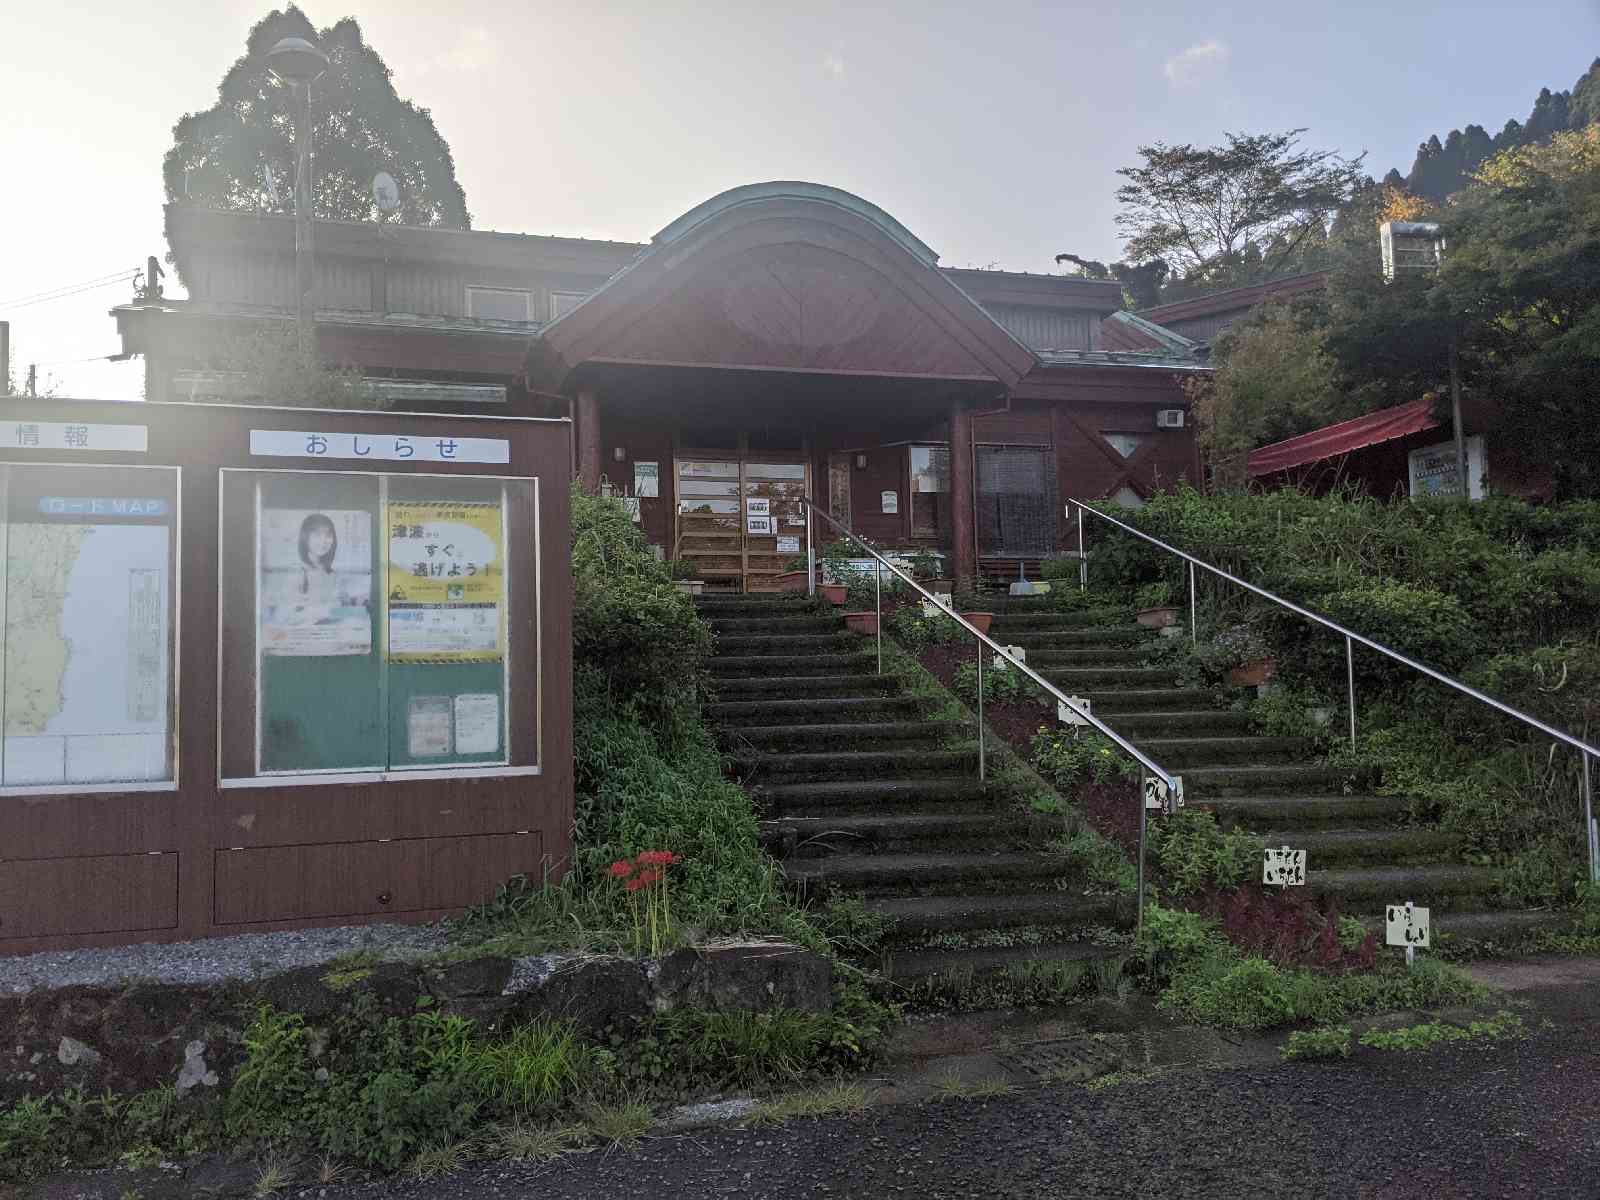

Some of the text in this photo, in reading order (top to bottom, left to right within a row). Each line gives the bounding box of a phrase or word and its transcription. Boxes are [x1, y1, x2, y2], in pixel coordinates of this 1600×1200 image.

[16, 423, 89, 447] 情報
[306, 434, 459, 459] おしらせ
